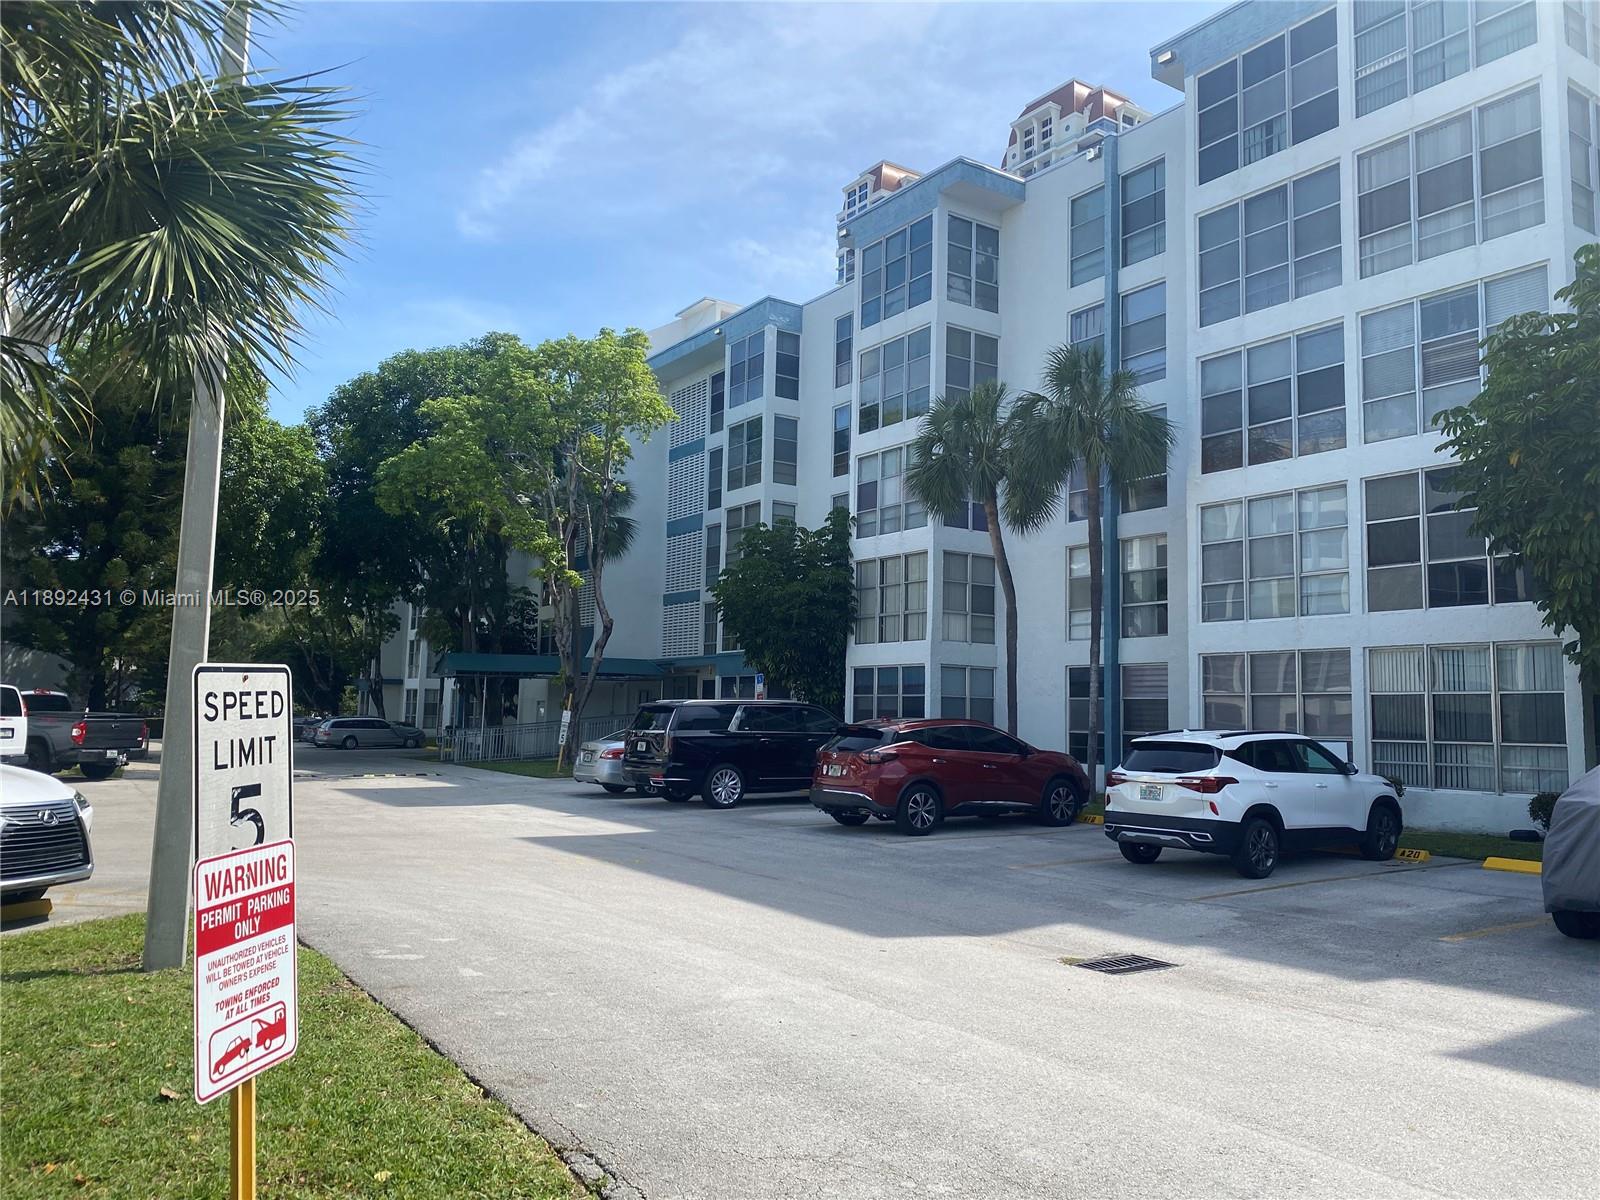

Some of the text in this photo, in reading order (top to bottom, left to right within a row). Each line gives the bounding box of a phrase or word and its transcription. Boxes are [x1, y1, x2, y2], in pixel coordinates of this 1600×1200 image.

[204, 690, 284, 722] SPEED
[214, 735, 276, 770] LIMIT
[231, 783, 265, 851] 5
[1400, 850, 1421, 859] A20
[204, 854, 287, 902] WARNING
[201, 888, 290, 932] PERMIT PARKING
[235, 915, 261, 940] ONLY
[205, 944, 289, 984] WILL BE TOWED AT VEHICLE
[207, 934, 286, 971] UNAUTHORIZED VEHICLES
[218, 960, 277, 991] OWNER'S EXPENSE
[215, 976, 280, 1013] TOWING ENFORCED
[225, 991, 271, 1020] AT ALL TIMES
